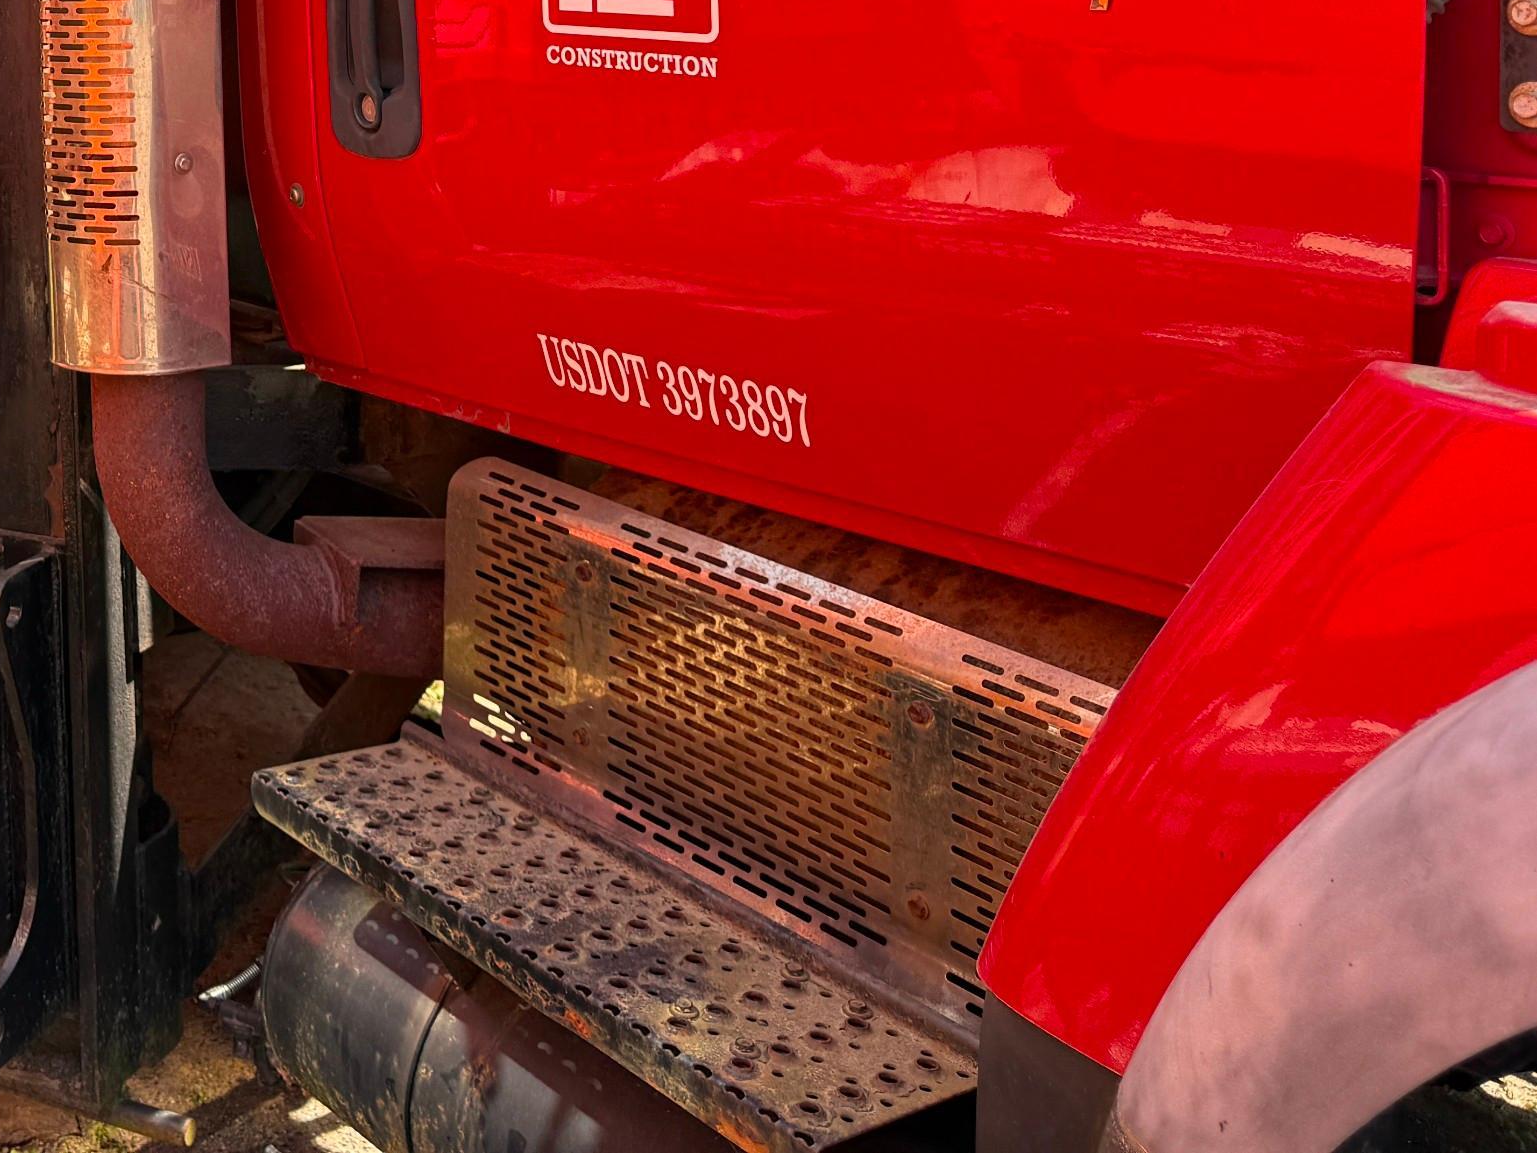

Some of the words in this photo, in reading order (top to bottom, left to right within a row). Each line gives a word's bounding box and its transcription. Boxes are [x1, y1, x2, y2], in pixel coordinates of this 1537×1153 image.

[546, 45, 718, 78] CONSTRUCTION
[537, 333, 651, 409] USDOT
[657, 360, 811, 448] 3973897
